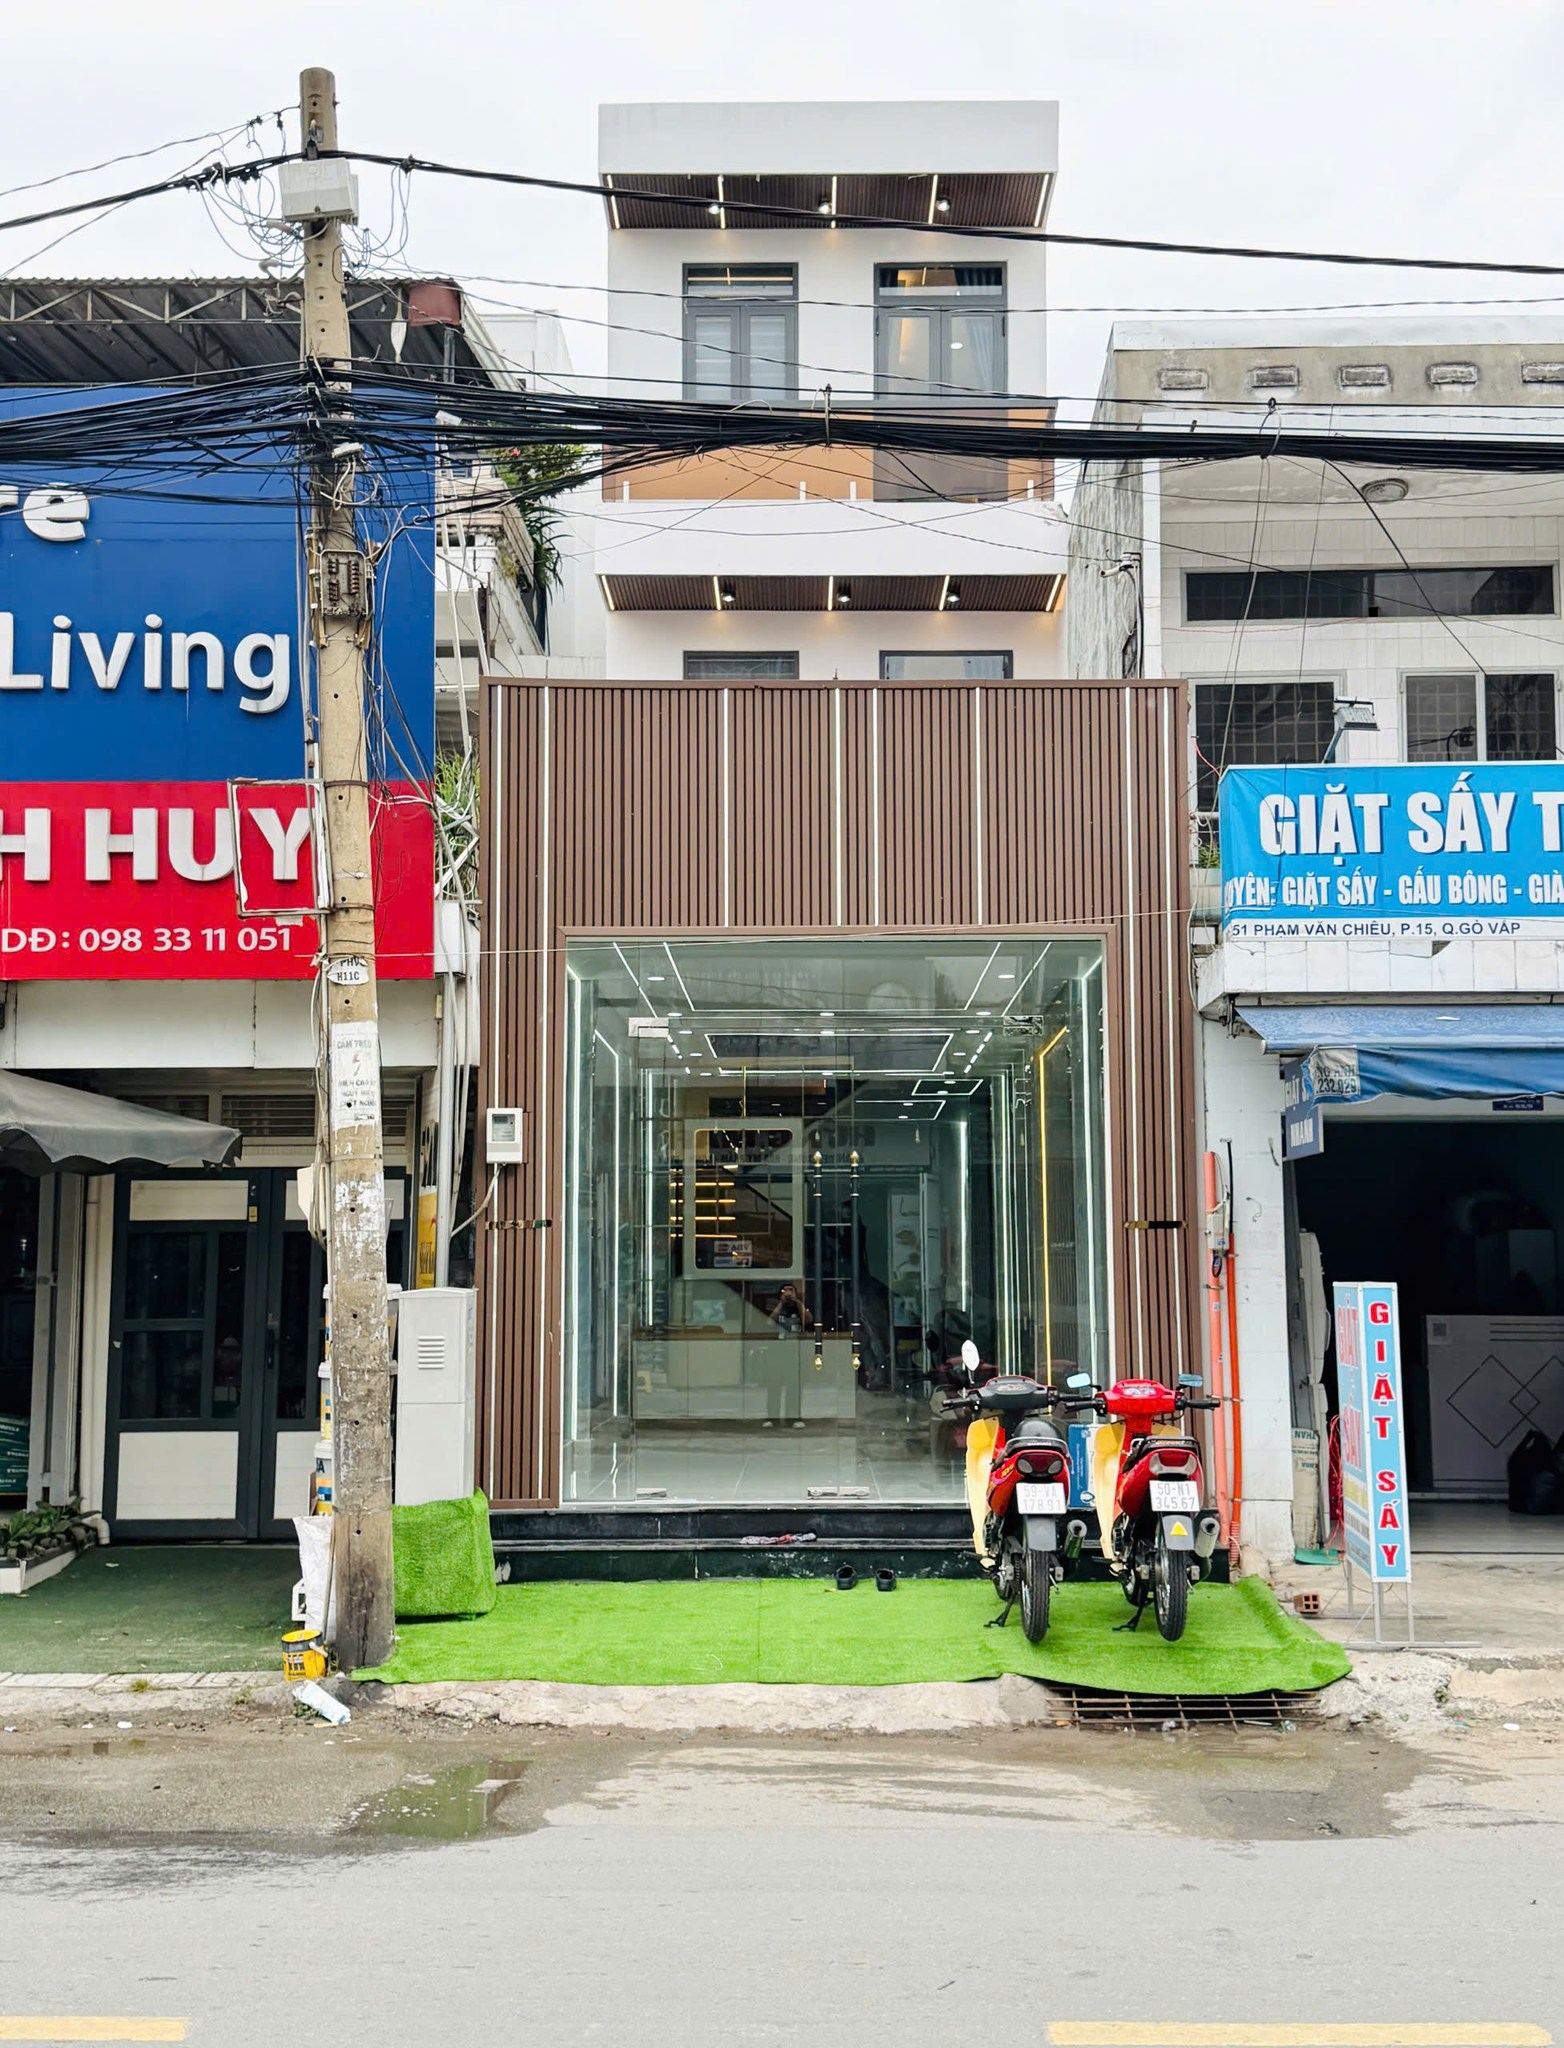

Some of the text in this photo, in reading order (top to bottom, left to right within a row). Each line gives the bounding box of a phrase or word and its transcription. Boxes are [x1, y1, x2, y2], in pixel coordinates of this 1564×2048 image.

[0, 612, 290, 714] Living
[1259, 783, 1389, 866] GIẶT
[1407, 772, 1516, 853] SẤY
[85, 808, 313, 881] HUY
[1282, 872, 1330, 911] GIẶT
[1337, 866, 1377, 906] SẤY
[1398, 865, 1441, 905] GẤU
[1448, 870, 1508, 905] BÔNG
[2, 927, 290, 952] DĐ: 098 33 11 051
[1254, 924, 1299, 938] PHẠM
[1305, 921, 1337, 936] VĂN
[1401, 922, 1437, 937] P.15,
[336, 971, 360, 981] H11C
[1369, 1302, 1401, 1567] GIẶT SẤY
[1155, 1496, 1195, 1510] 345.67
[1157, 1483, 1191, 1496] 50-N1
